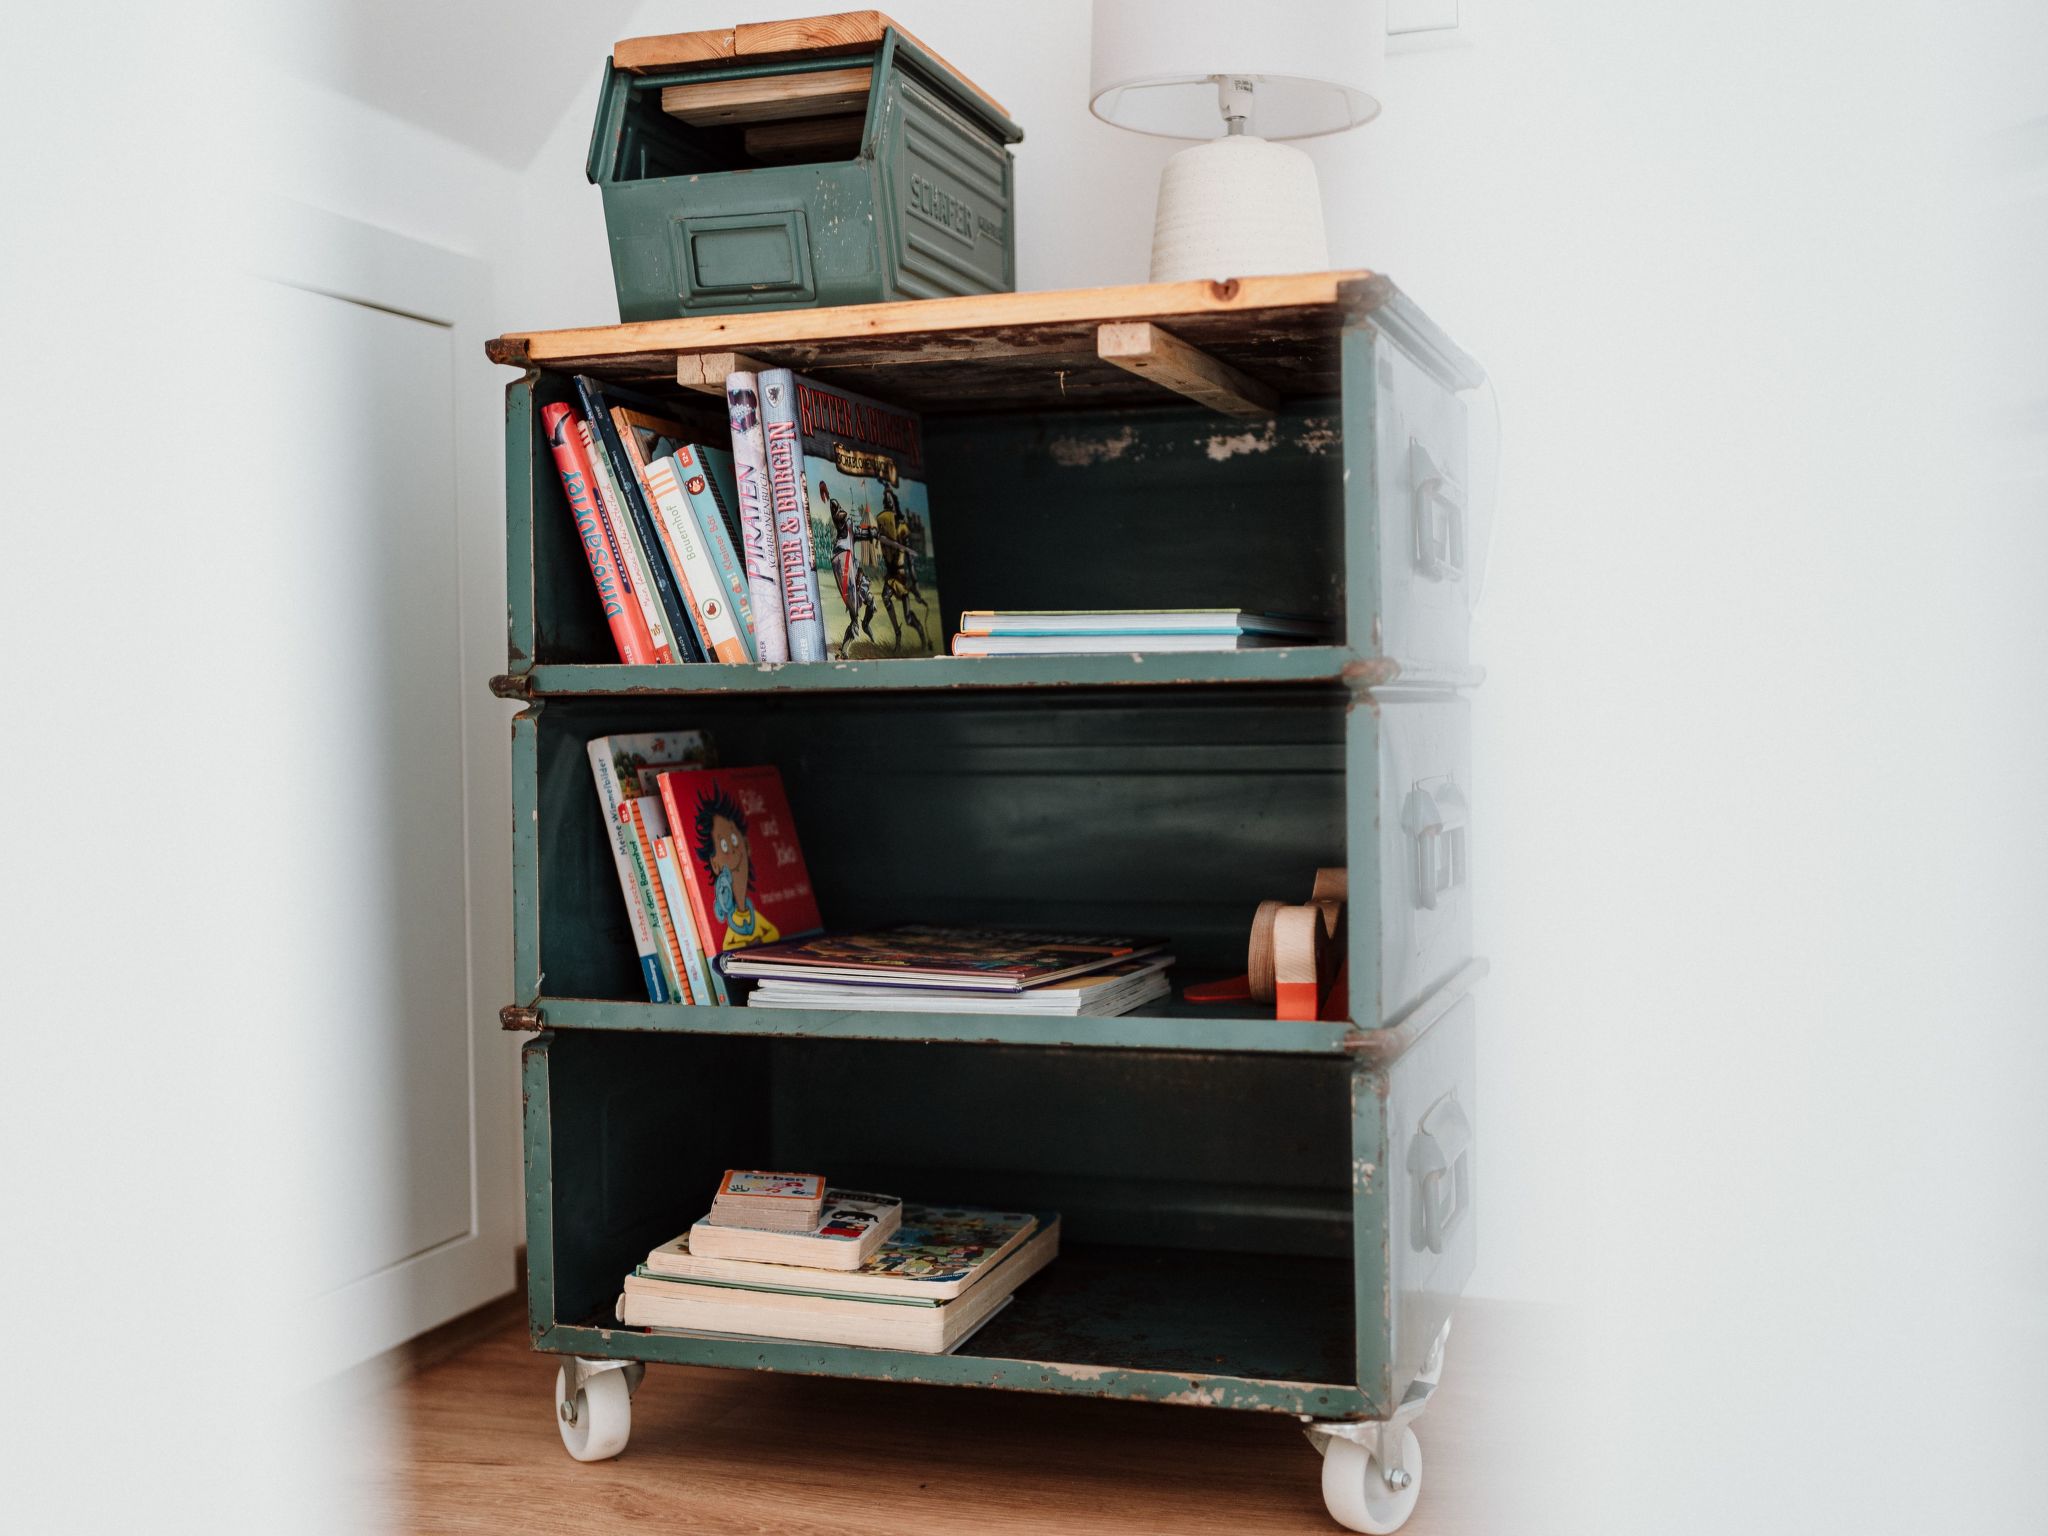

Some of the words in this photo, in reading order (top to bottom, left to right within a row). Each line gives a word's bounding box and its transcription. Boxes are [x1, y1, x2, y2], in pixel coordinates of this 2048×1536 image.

[796, 383, 854, 439] RITTER
[855, 402, 867, 442] &
[682, 452, 690, 464] 12+
[767, 420, 798, 513] BURGEN
[597, 499, 627, 584] SCHABLONENBUCH
[665, 504, 696, 561] Bauernhof
[706, 514, 719, 533] Bär
[737, 462, 776, 585] PIRATEN
[759, 472, 776, 573] SCHABLONENBUCH
[779, 516, 801, 535] &
[561, 470, 623, 619] Dinosaurier
[715, 534, 734, 572] Kleiner
[781, 537, 815, 624] RITTER
[760, 640, 768, 661] RFLER
[598, 757, 620, 824] Wimmelbilder
[615, 824, 628, 856] Meine
[628, 840, 648, 887] Bauernhof
[628, 872, 643, 904] suchen
[643, 887, 655, 910] dem
[634, 909, 649, 942] Sachen
[649, 910, 660, 929] Auf
[743, 1173, 807, 1182] Farben
